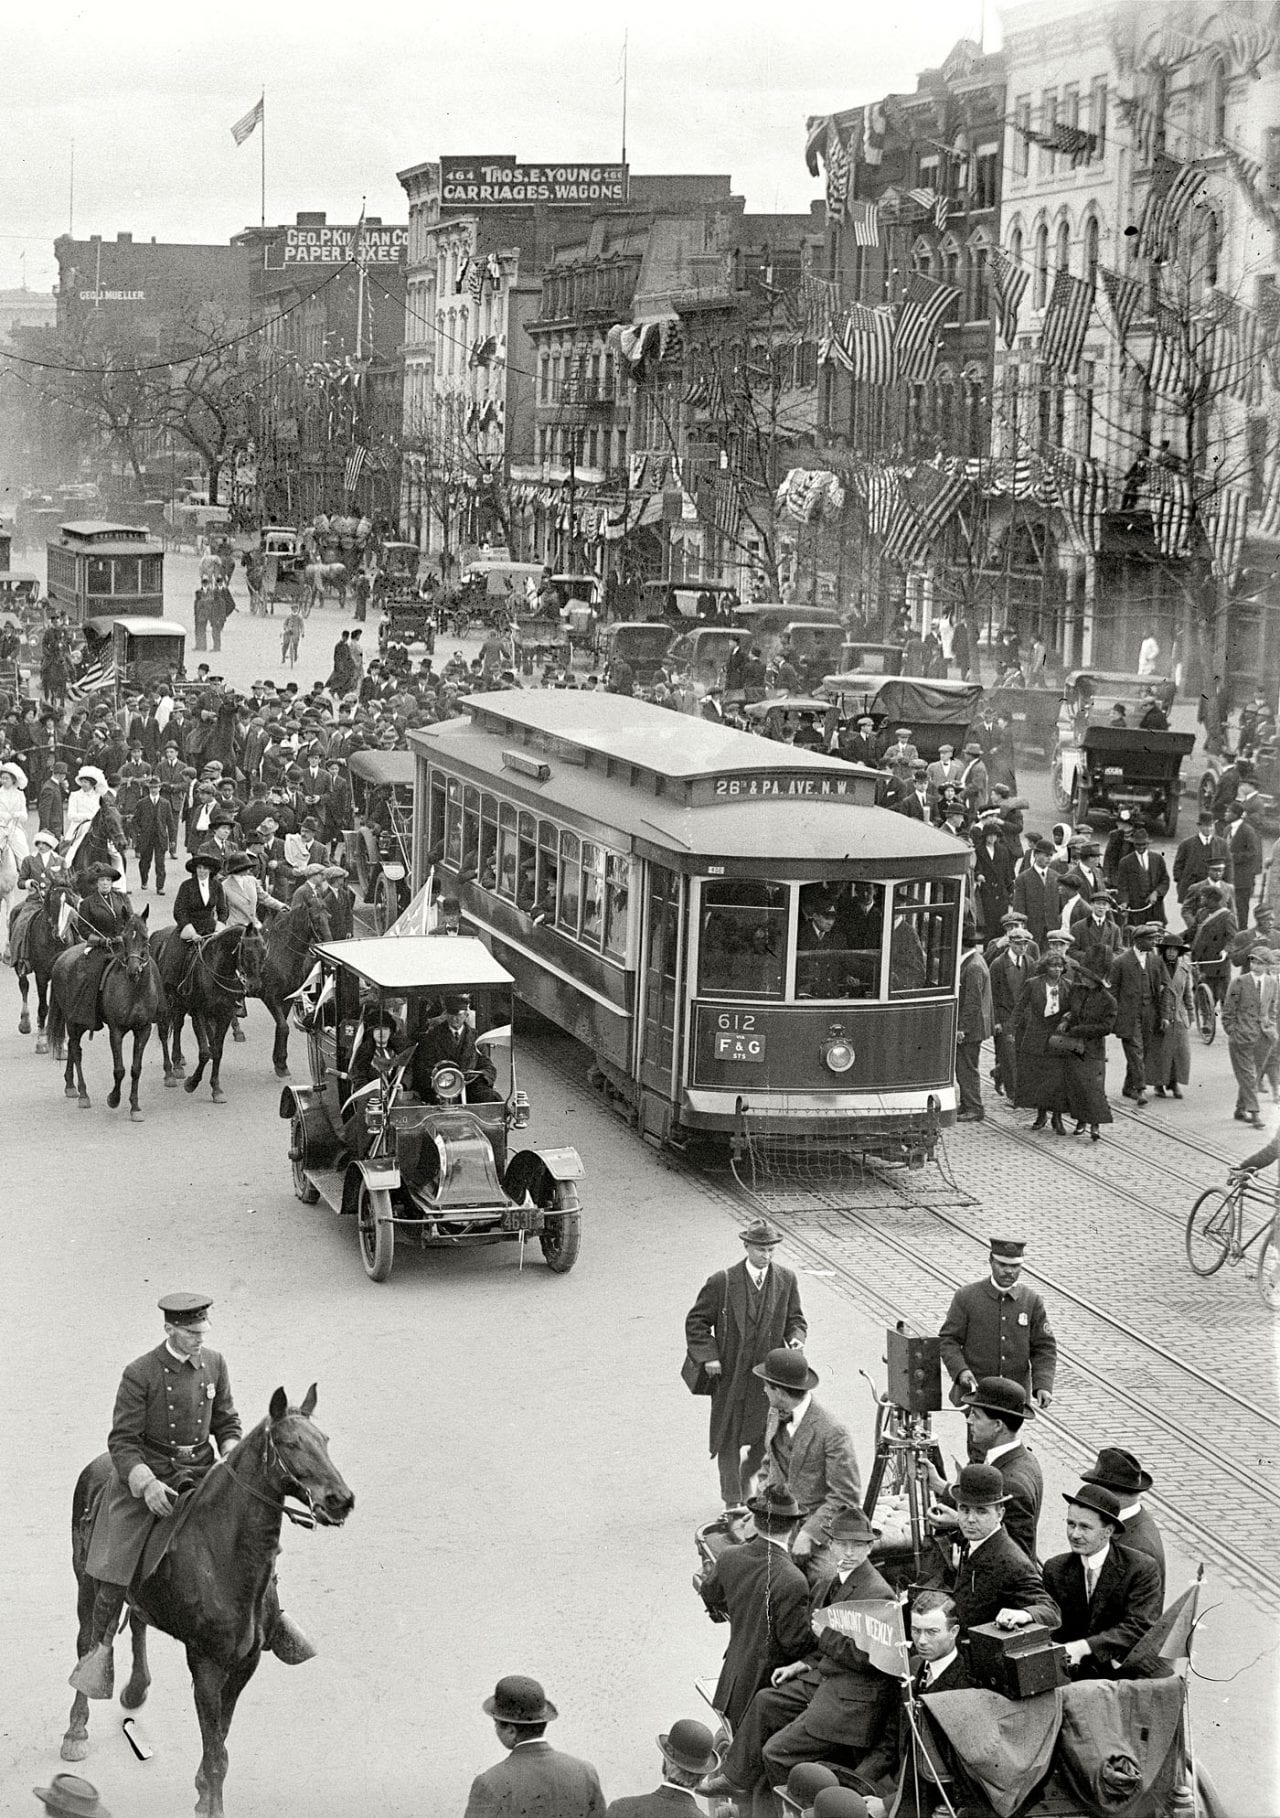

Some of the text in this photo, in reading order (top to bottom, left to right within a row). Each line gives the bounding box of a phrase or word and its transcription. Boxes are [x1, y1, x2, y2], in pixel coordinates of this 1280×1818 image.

[446, 171, 474, 180] 464
[284, 246, 341, 261] PAPER
[749, 781, 758, 795] &
[762, 780, 784, 795] PA.
[788, 780, 818, 795] AVE.
[718, 1013, 756, 1031] 612
[720, 1038, 761, 1055] F & G
[864, 1613, 894, 1647] WEEKLY
